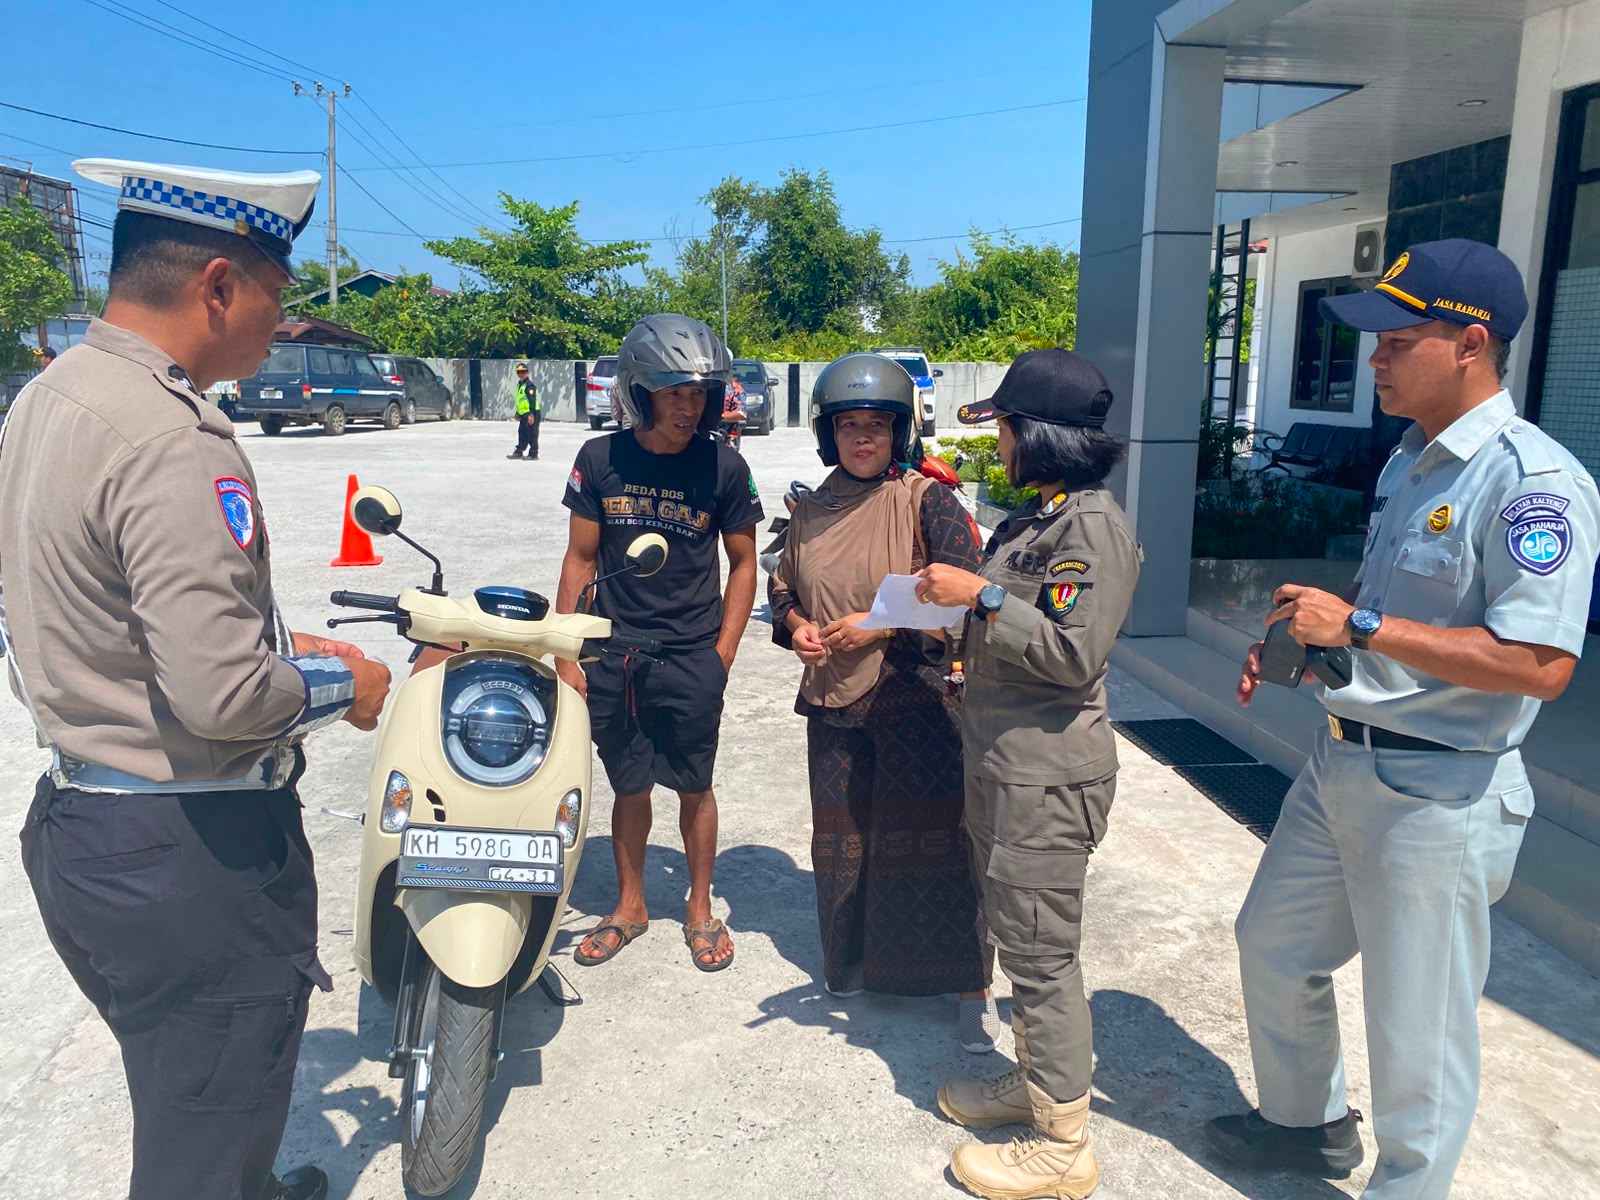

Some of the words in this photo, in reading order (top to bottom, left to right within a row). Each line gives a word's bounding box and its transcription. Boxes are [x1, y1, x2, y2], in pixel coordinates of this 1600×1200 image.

[1432, 297, 1454, 310] JASA
[1455, 302, 1491, 321] RAHARJA
[624, 483, 657, 497] BEDA
[661, 488, 685, 500] BOS
[497, 603, 530, 613] HONDA
[410, 833, 439, 855] KH
[455, 836, 511, 858] 5980
